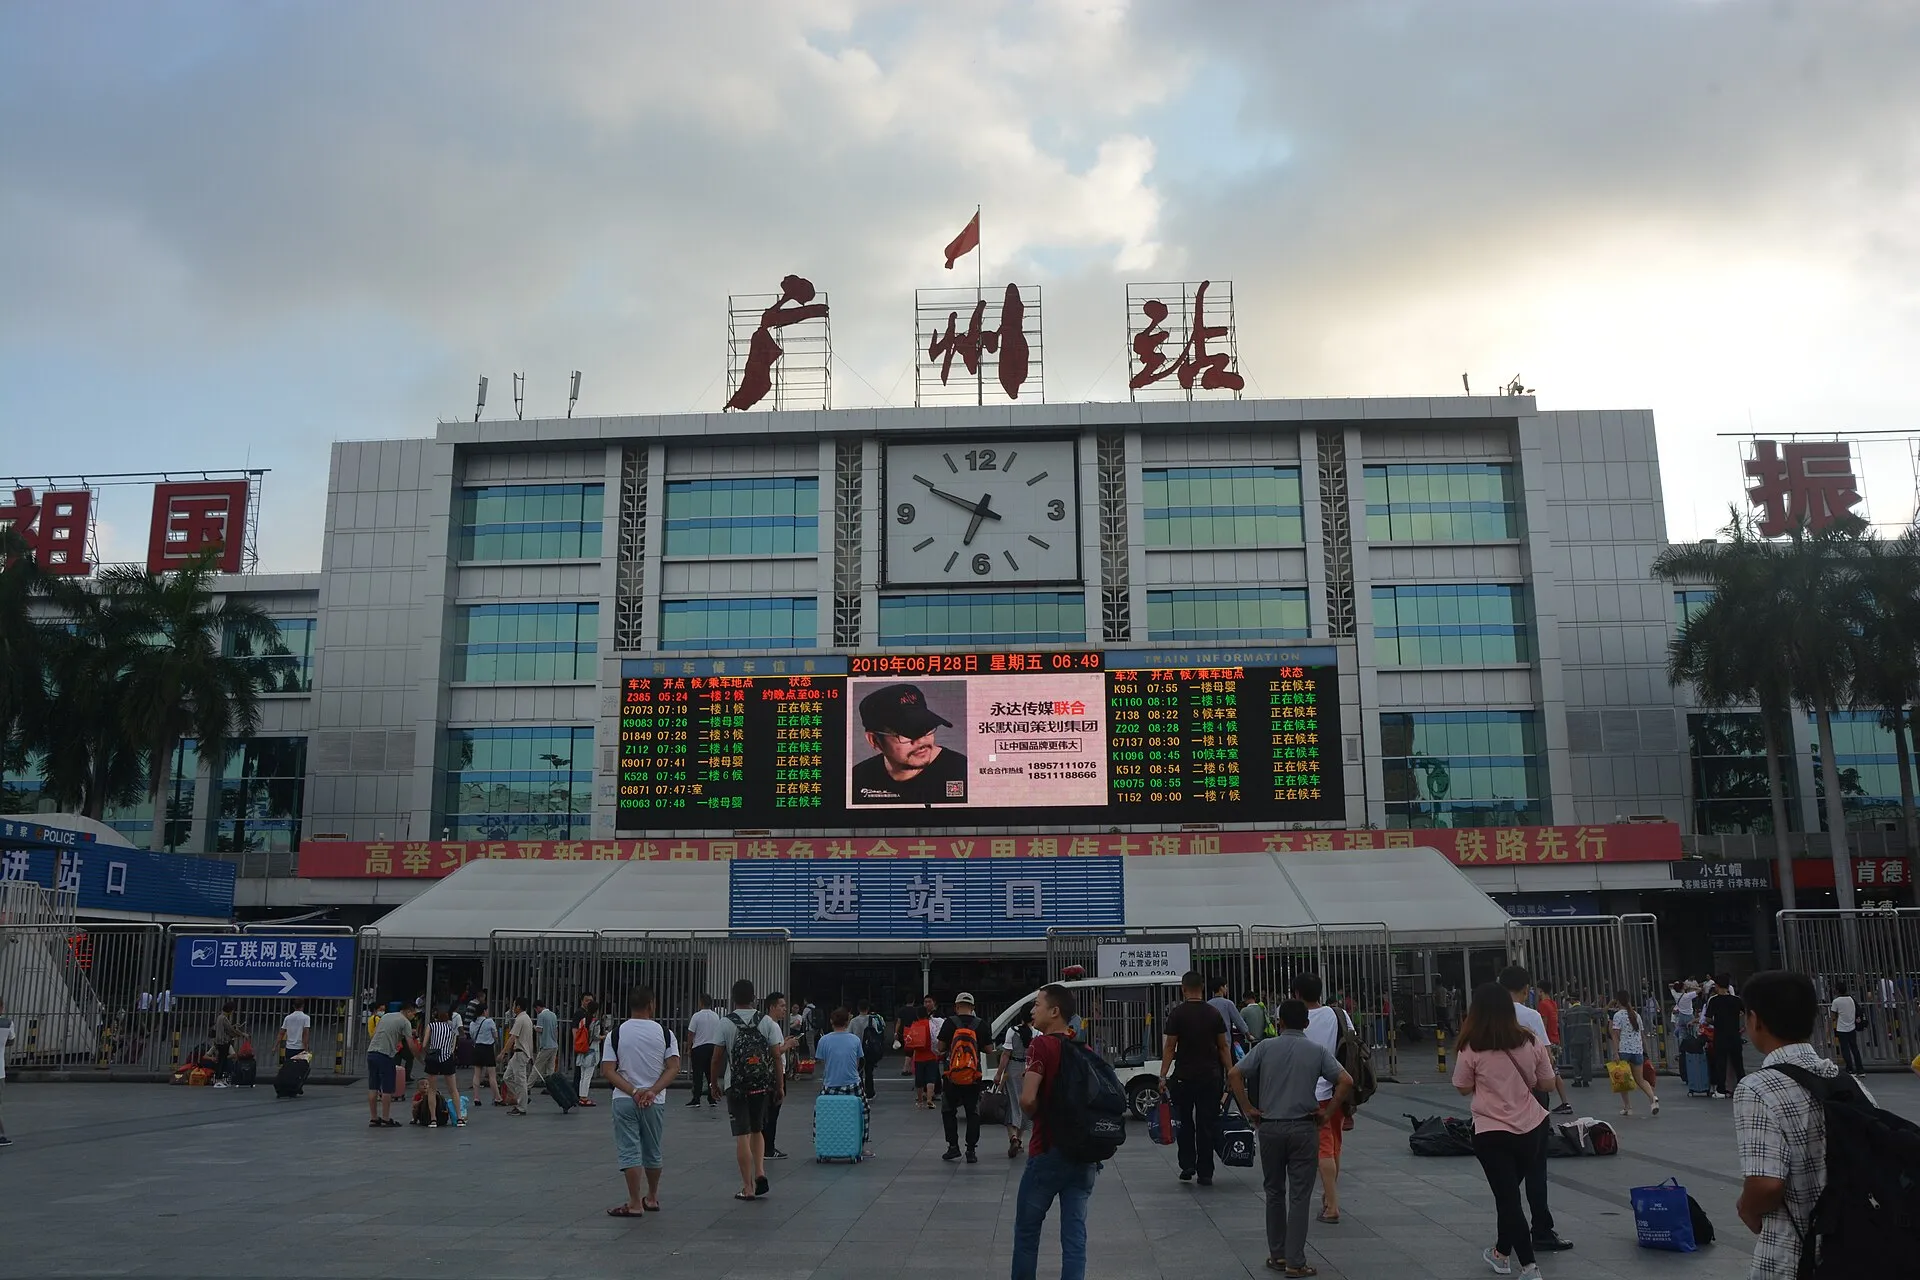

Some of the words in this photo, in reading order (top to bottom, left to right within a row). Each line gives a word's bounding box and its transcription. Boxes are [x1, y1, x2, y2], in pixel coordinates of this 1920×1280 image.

[723, 275, 1244, 410] 广州站
[965, 449, 997, 471] 12
[1744, 440, 1870, 539] 振
[897, 503, 916, 525] 9
[1047, 499, 1066, 521] 3
[972, 553, 991, 575] 6
[852, 655, 977, 672] 2019年06月28日
[991, 654, 1042, 670] 星期五
[1053, 654, 1098, 668] 06:49
[1144, 653, 1188, 664] TRAIN
[1197, 652, 1301, 663] INFORMATION
[1113, 670, 1139, 681] 车次
[1150, 670, 1175, 680] 开点
[1179, 668, 1244, 680] 候/乘车地点
[1281, 667, 1303, 678] 状态
[629, 679, 650, 690] 车次
[664, 678, 685, 689] 开点
[691, 677, 755, 688] 候/乘车地点
[787, 676, 813, 687] 状态
[1114, 685, 1137, 693] K951
[1147, 684, 1177, 693] 07:55
[1270, 680, 1315, 691] 正在候车
[627, 693, 650, 702] Z385
[659, 692, 688, 701] 05:24
[699, 690, 744, 701] 一楼2候
[762, 689, 838, 700] 约晚点至08:15
[1112, 698, 1142, 706] K1160
[1148, 697, 1177, 706] 08:12
[1191, 695, 1236, 706] 二楼5候
[1271, 693, 1316, 704] 正在候车
[624, 706, 652, 714] C7073
[658, 705, 687, 714] 07:19
[699, 703, 744, 714] 一楼1候
[777, 702, 822, 713] 正在候车
[990, 701, 1086, 716] 永达传媒联合
[1116, 711, 1139, 720] Z138
[1148, 710, 1178, 719] 08:22
[1193, 708, 1237, 719] 8候车室
[1271, 706, 1316, 717] 正在候车
[624, 719, 652, 727] K9083
[658, 718, 687, 727] 07:26
[777, 715, 822, 726] 正在候车
[979, 720, 1098, 734] 张默闻策划集团
[1116, 724, 1139, 733] Z202
[1149, 724, 1179, 732] 08:28
[1192, 721, 1237, 732] 二楼4候
[1272, 720, 1317, 731] 正在候车
[623, 732, 651, 740] D1849
[658, 732, 686, 740] 07:28
[699, 729, 743, 740] 二楼3候
[777, 728, 822, 739] 正在候车
[1113, 738, 1143, 746] C7137
[1149, 737, 1179, 746] 08:30
[1192, 735, 1238, 746] 一楼1候
[1272, 733, 1318, 744] 正在候车
[626, 745, 648, 754] Z112
[658, 745, 686, 753] 07:36
[699, 743, 743, 754] 二楼4候
[777, 741, 822, 752] 正在候车
[999, 741, 1078, 751] 让中国品牌更伟大
[1113, 752, 1143, 760] K1096
[1150, 751, 1179, 760] 08:45
[1192, 749, 1238, 760] 10候车室
[1273, 747, 1319, 758] 正在候车
[622, 759, 651, 767] K9017
[657, 759, 684, 767] 07:41
[777, 755, 821, 766] 正在候车
[1028, 762, 1097, 770] 18957111076
[1117, 765, 1140, 774] K512
[1150, 765, 1180, 773] 08:54
[1193, 762, 1239, 774] 二楼6候
[1274, 761, 1319, 772] 正在候车
[625, 772, 648, 780] K528
[657, 772, 685, 780] 07:45
[698, 770, 742, 781] 二楼6候
[776, 769, 821, 780] 正在候车
[979, 767, 1024, 775] 联合合作热线
[1028, 771, 1097, 779] 18511188666
[1114, 779, 1144, 788] K9075
[1150, 778, 1180, 787] 08:55
[1274, 774, 1320, 786] 正在候车
[621, 786, 648, 794] C6871
[656, 785, 685, 794] 07:47
[776, 782, 821, 794] 正在候车
[1118, 793, 1141, 802] T152
[1151, 792, 1181, 801] 09:00
[1194, 790, 1240, 801] 一楼7候
[1275, 788, 1320, 800] 正在候车
[621, 800, 650, 808] K9063
[656, 799, 685, 807] 07:48
[776, 796, 821, 807] 正在候车
[5, 823, 28, 838] 警察
[43, 829, 76, 845] POLICE
[1455, 827, 1608, 862] 铁路先行
[1, 849, 128, 896] 进站口
[1699, 863, 1742, 877] 小红帽
[1856, 860, 1912, 884] 肯德
[813, 874, 1043, 922] 进站口
[1502, 904, 1547, 915] 网取票处
[1861, 900, 1899, 917] 肯德
[219, 940, 338, 961] 互联网取票处
[1119, 950, 1168, 959] 广州站进站口
[219, 959, 244, 968] 12306
[246, 959, 291, 969] Automatic
[293, 960, 333, 969] Ticketing
[1119, 959, 1169, 967] 停止营业时间
